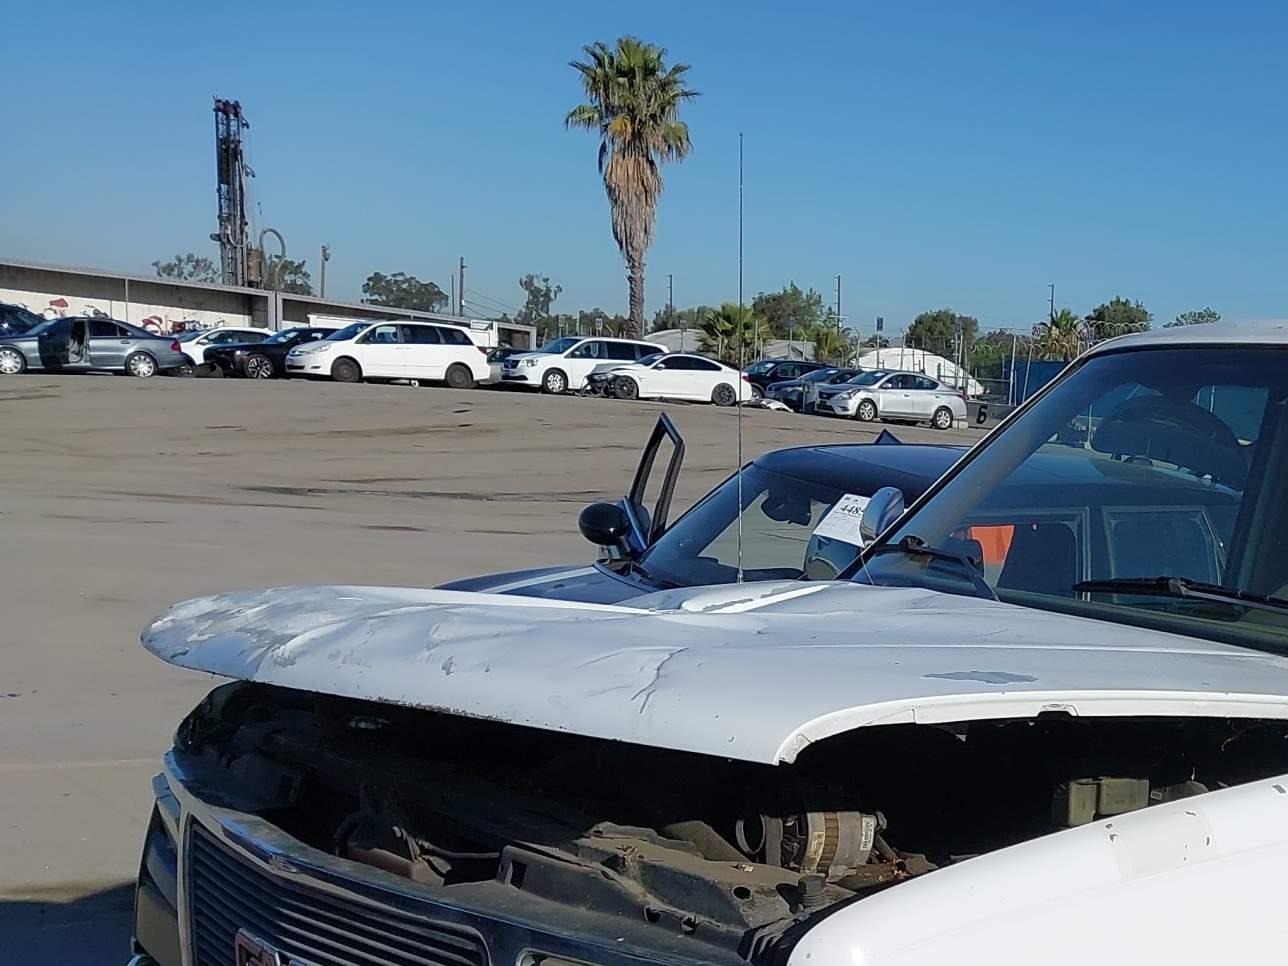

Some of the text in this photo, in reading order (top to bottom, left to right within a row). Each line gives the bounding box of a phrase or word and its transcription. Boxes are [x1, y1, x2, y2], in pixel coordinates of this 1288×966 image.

[1032, 326, 1041, 336] 20
[976, 405, 988, 424] 6
[840, 504, 864, 516] 448
